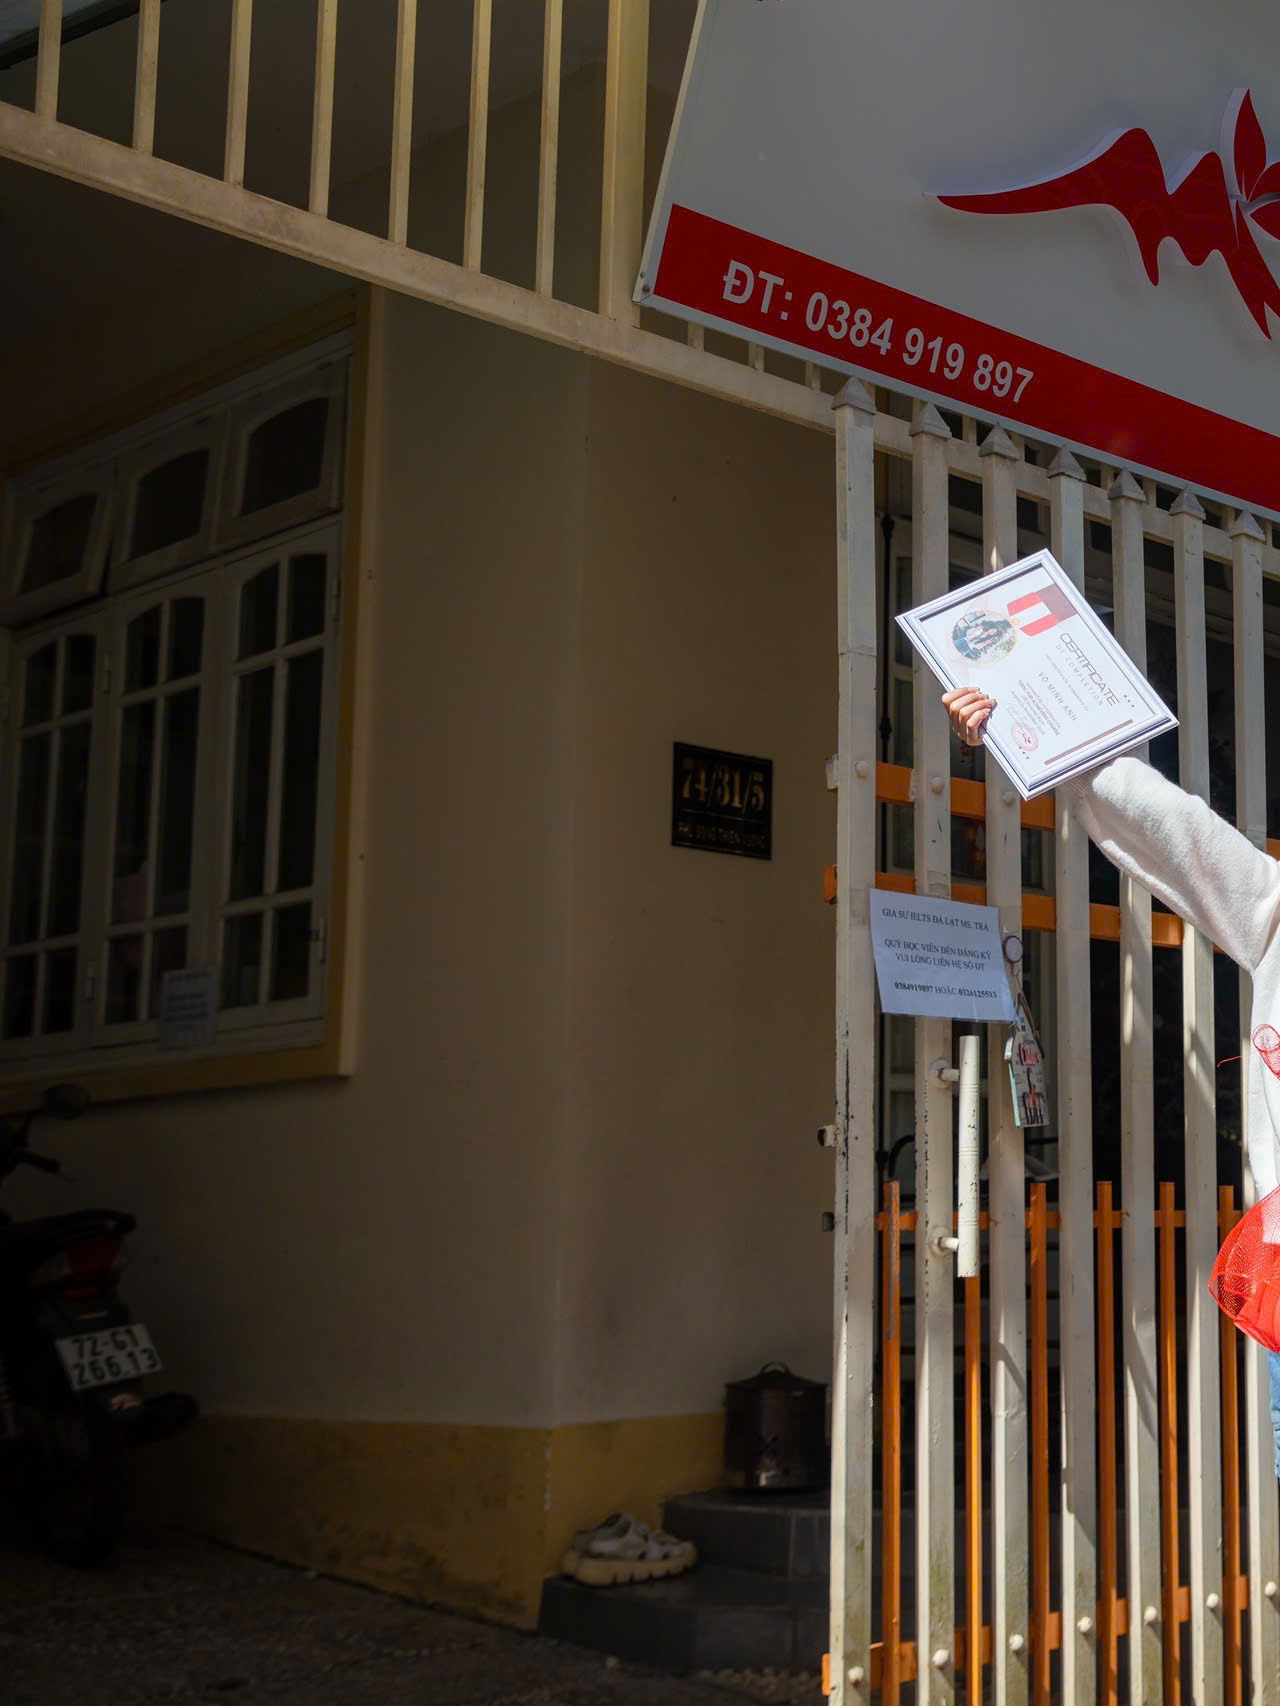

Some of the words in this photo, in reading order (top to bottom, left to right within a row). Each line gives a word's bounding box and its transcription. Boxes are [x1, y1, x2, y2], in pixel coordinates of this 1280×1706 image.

[722, 259, 793, 321] ĐT:
[805, 292, 894, 356] 0384
[902, 327, 965, 381] 919
[972, 353, 1034, 403] 897
[1059, 632, 1120, 707] CERTIFICATE
[1046, 684, 1066, 705] MINH
[1062, 704, 1079, 721] ANH
[882, 907, 897, 918] GIA
[898, 909, 910, 920] SƯ
[910, 912, 931, 923] IELTS
[932, 914, 944, 925] ĐÀ
[945, 917, 960, 928] LẠT
[961, 919, 974, 929] MS.
[975, 921, 989, 932] TRÀ
[895, 952, 910, 962] VUI
[903, 940, 919, 952] HỌC
[894, 981, 934, 993] 0384919897
